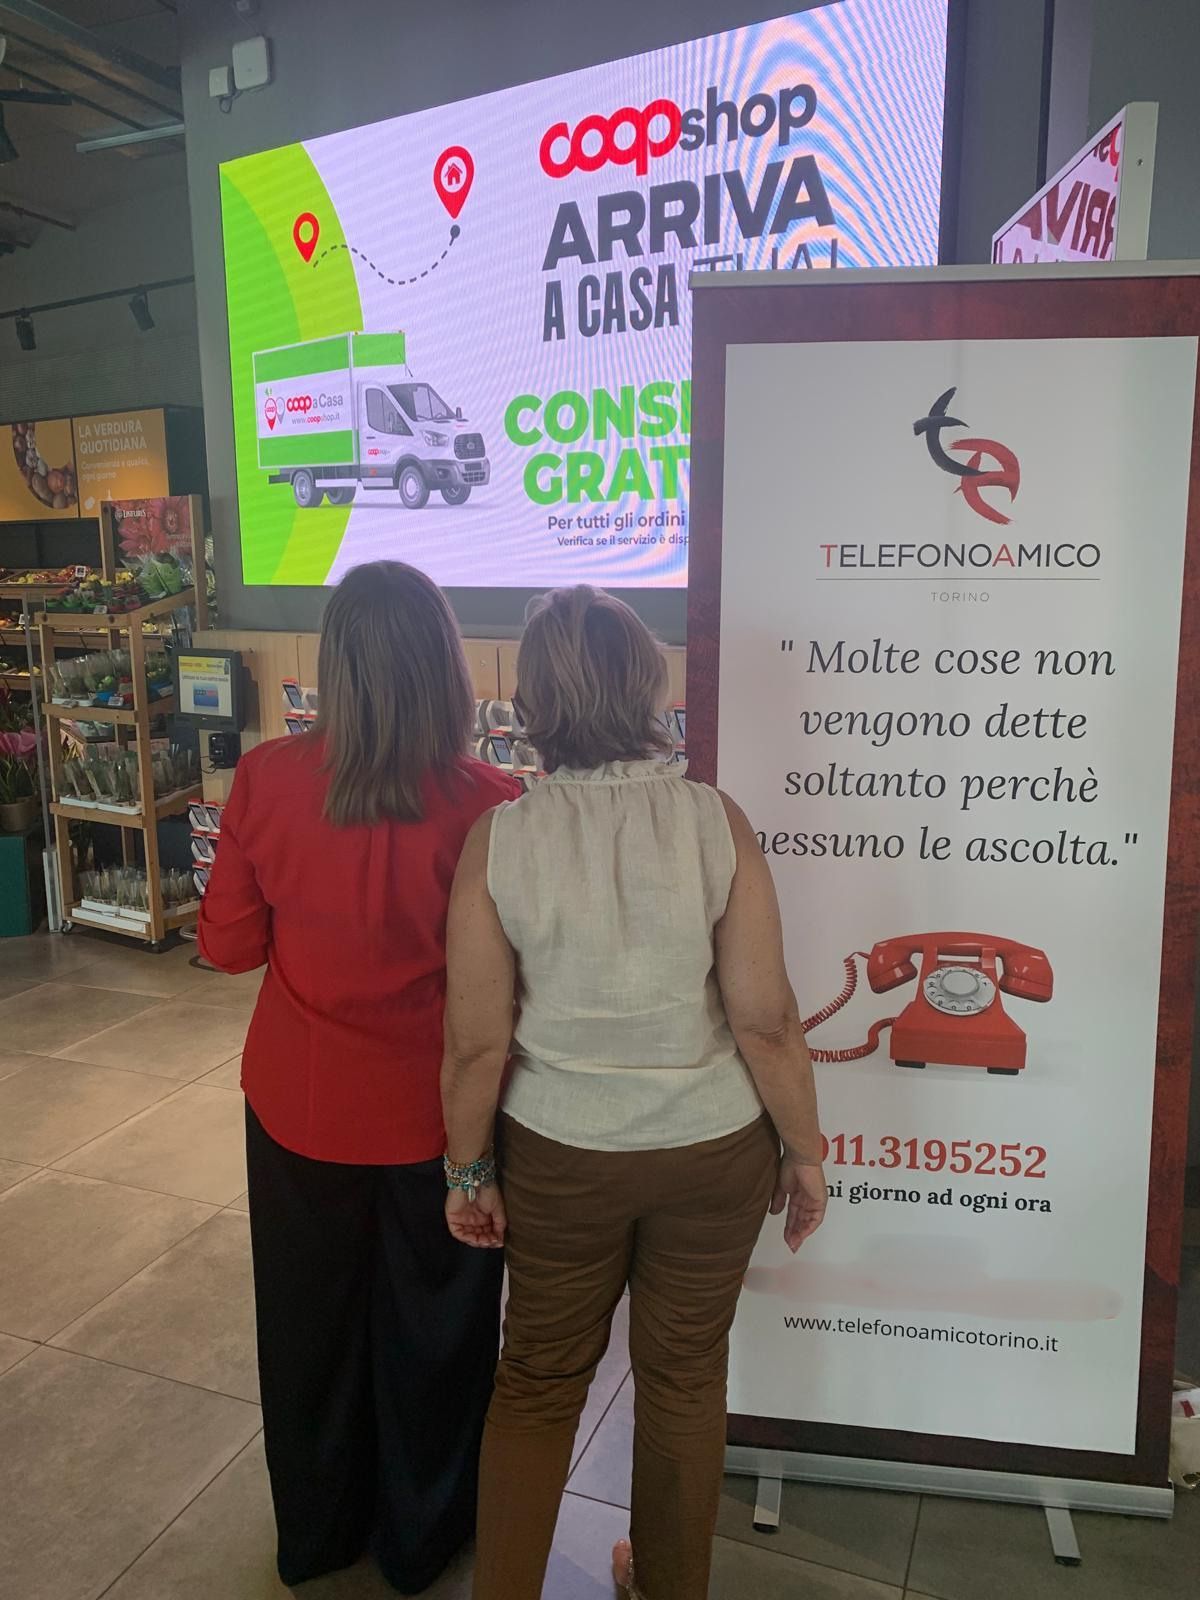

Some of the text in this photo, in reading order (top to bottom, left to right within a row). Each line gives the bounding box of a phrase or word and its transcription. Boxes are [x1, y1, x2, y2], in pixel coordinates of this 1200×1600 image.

[541, 154, 837, 271] ARRIVA
[543, 263, 680, 342] A CASA
[319, 393, 344, 408] Casa
[78, 420, 143, 438] LA VERDURA
[80, 436, 148, 454] QUOTIDIANA
[548, 510, 686, 531] Per tutti gli ordini
[557, 535, 594, 546] Verifica
[596, 537, 608, 546] se
[610, 535, 616, 545] il
[618, 534, 657, 545] servizio
[660, 534, 666, 545] è
[819, 543, 1101, 568] TELEFONOAMICO
[931, 591, 990, 602] TORINO
[806, 638, 920, 674] Molte
[935, 648, 1021, 675] cose
[1034, 648, 1116, 675] non
[800, 703, 1088, 747] vengono dette
[784, 762, 1099, 810] soltanto perchè
[919, 826, 951, 861] le
[965, 830, 1138, 866] ascolta."
[849, 1181, 921, 1205] giorno
[927, 1188, 953, 1206] ad
[959, 1191, 1009, 1213] ogni
[1014, 1197, 1052, 1213] ora
[783, 1314, 1059, 1352] www.telefonoamicotorino.it
